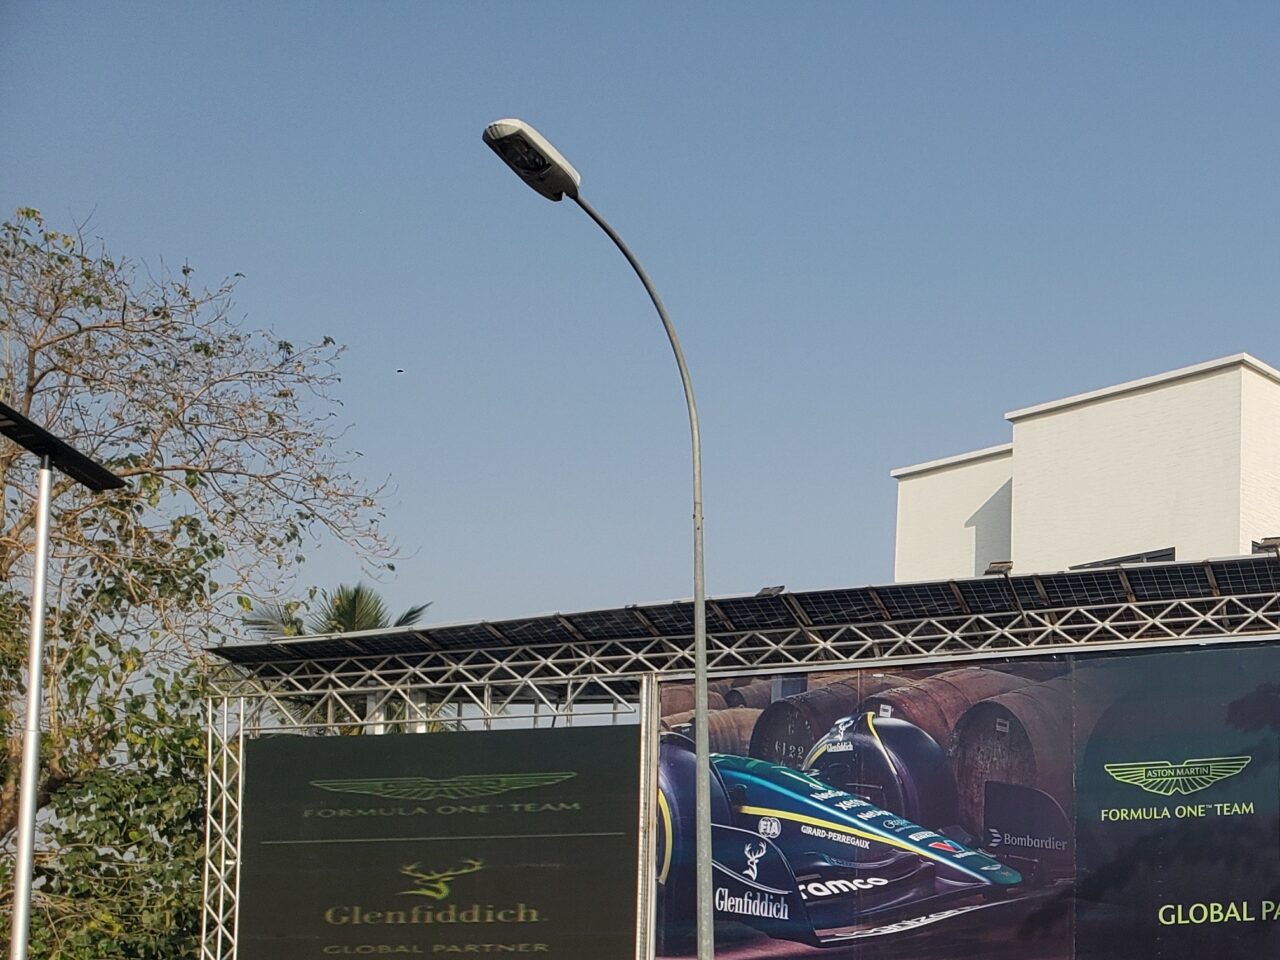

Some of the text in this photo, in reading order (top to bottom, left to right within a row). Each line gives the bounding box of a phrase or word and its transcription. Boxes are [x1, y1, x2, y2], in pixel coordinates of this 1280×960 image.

[1146, 765, 1209, 778] ASTON MARTIN
[303, 807, 426, 819] FORMULA
[512, 801, 581, 812] TEAM
[1101, 807, 1171, 821] FORMULA
[1214, 802, 1254, 816] TEAM
[800, 825, 870, 849] GIRARD-PERREGAUX
[1003, 832, 1067, 851] Bombardier
[715, 887, 789, 920] Glenfiddich
[323, 903, 539, 925] Glenfiddich
[1158, 902, 1255, 926] GLOBAL
[322, 942, 550, 955] GLOBAL PARTNER
